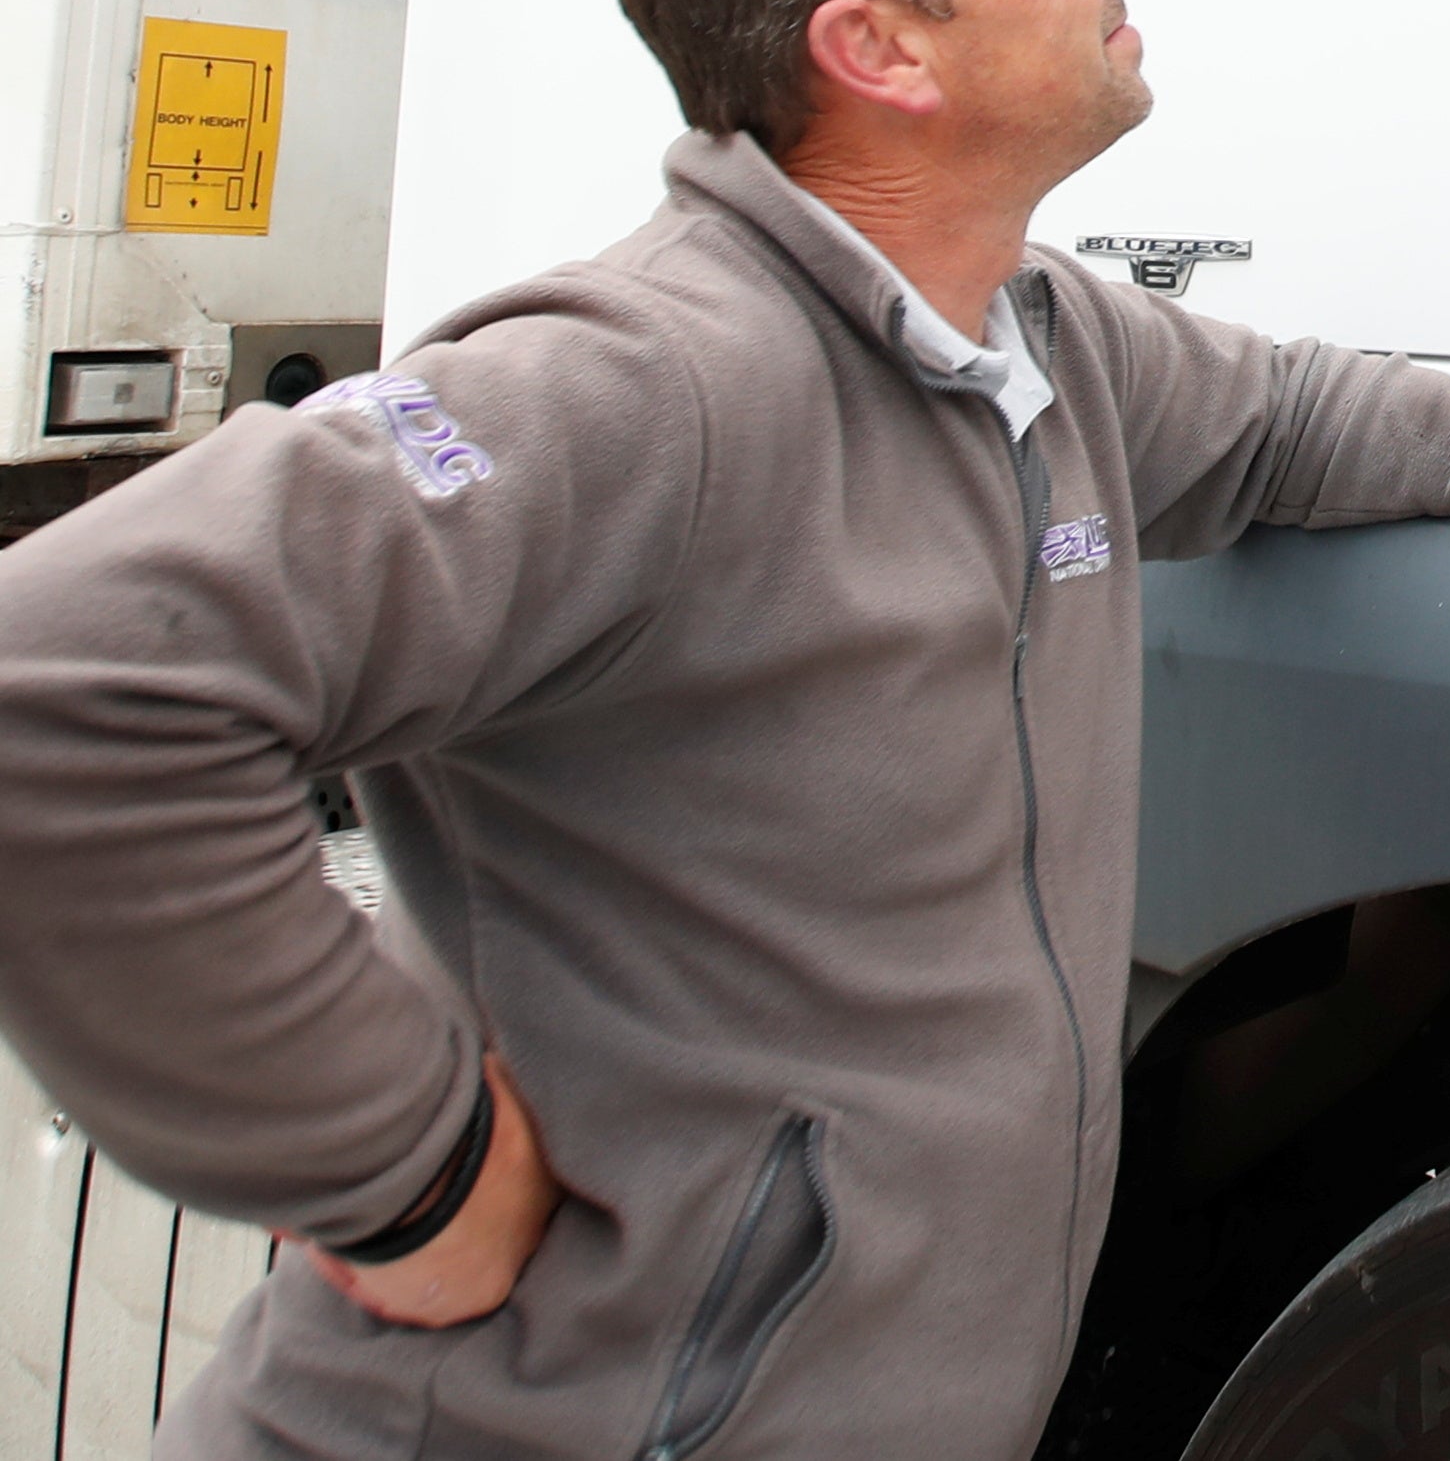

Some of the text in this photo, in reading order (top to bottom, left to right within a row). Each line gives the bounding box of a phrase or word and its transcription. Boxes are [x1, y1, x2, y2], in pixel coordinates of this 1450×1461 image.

[157, 112, 247, 128] BODY HEIGHT
[1084, 237, 1238, 255] BLUETEC
[1140, 260, 1177, 289] 6
